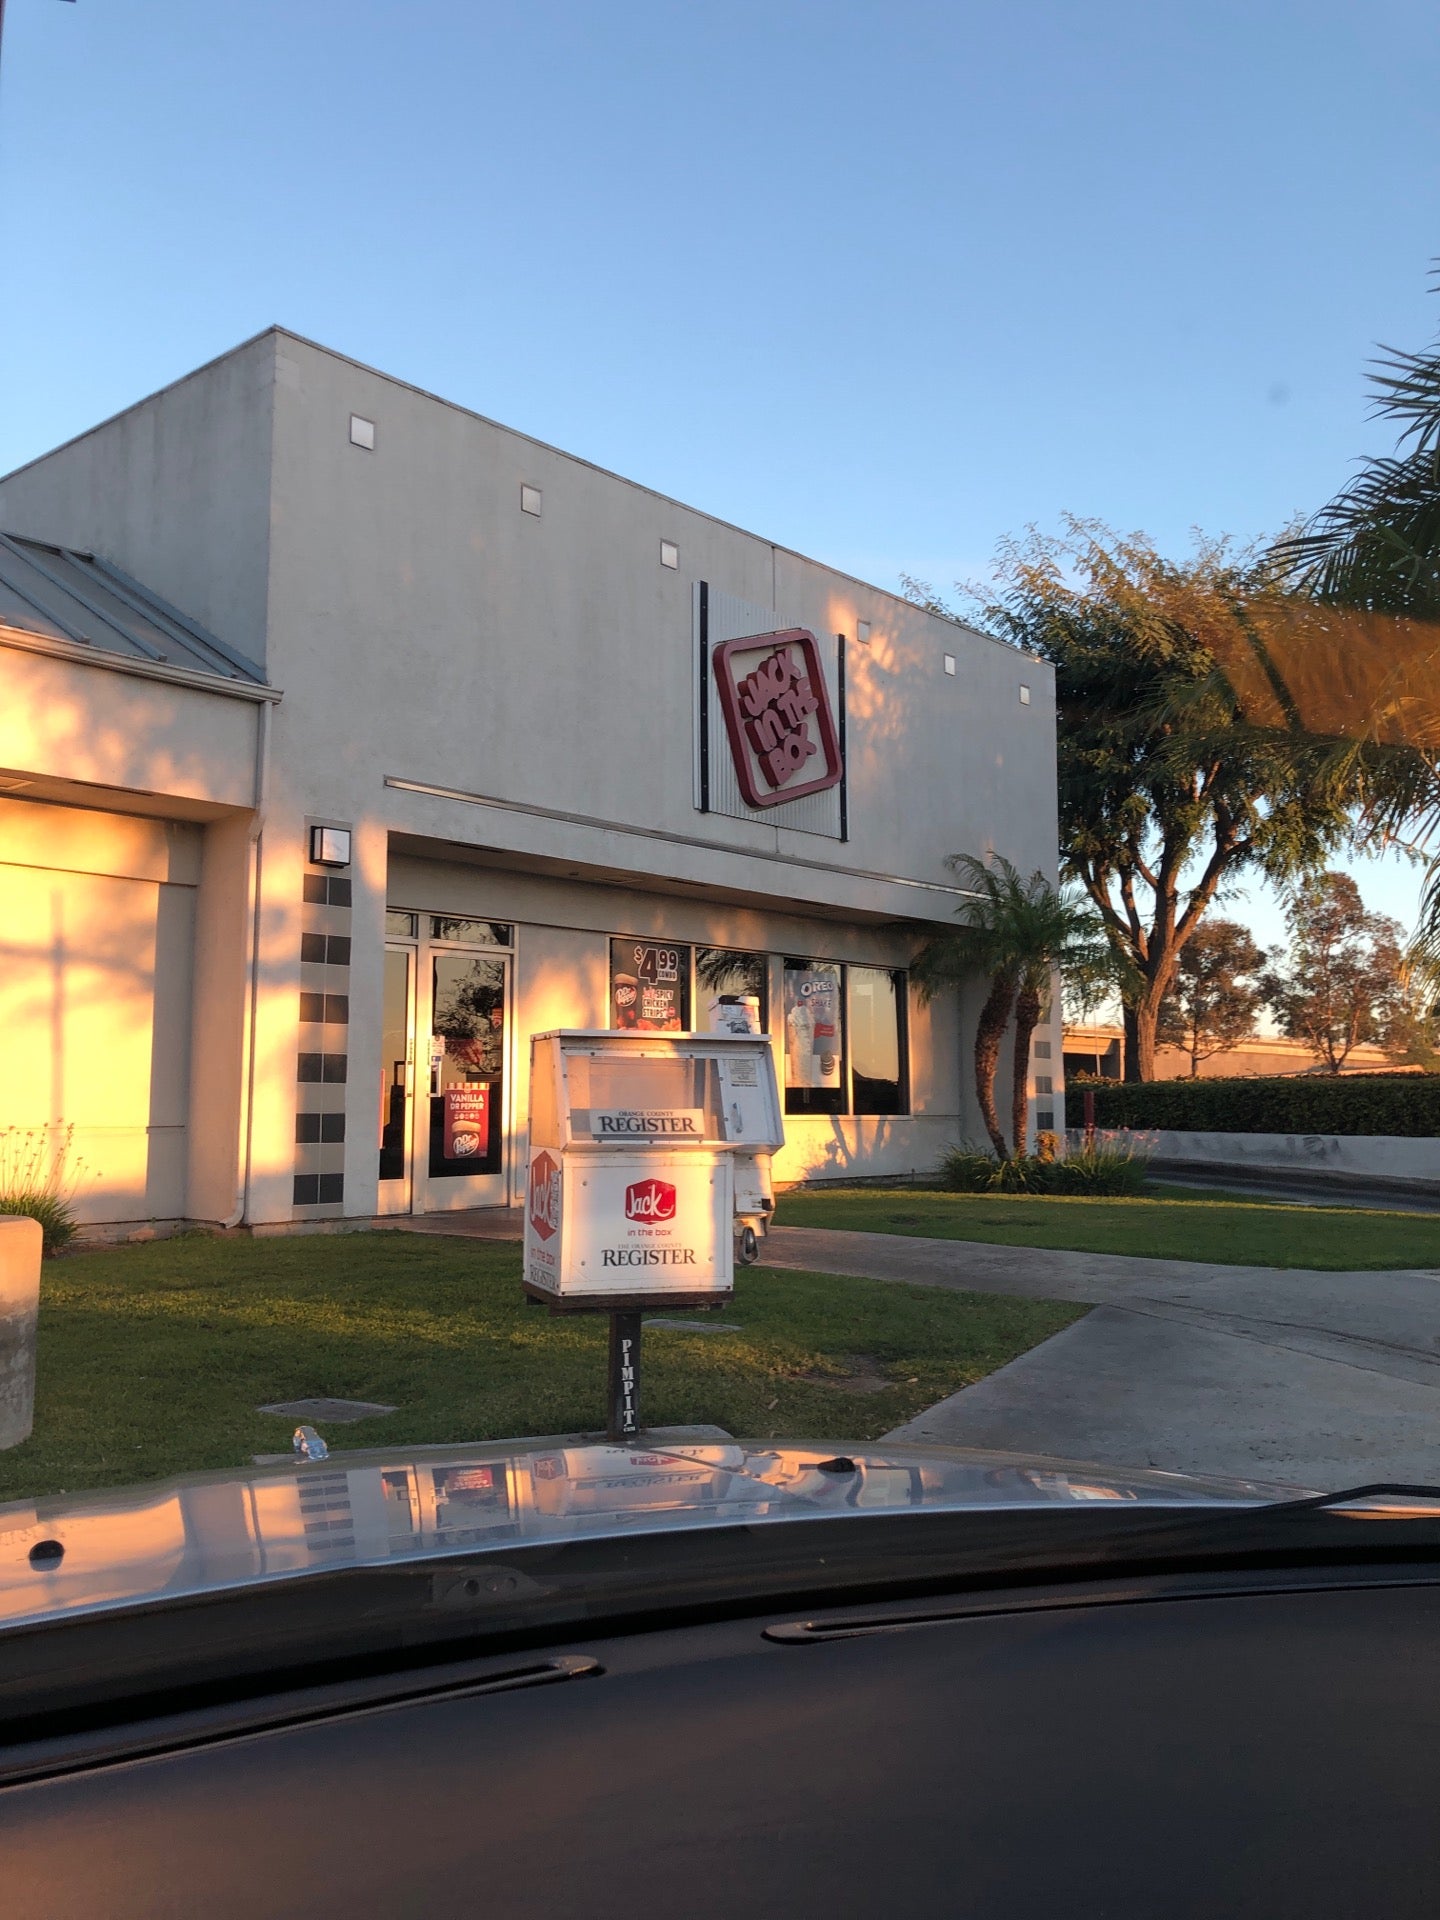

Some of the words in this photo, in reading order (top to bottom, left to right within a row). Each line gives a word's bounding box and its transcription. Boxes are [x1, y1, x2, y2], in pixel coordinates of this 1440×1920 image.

[740, 648, 801, 718] JACK
[748, 708, 786, 752] IN
[777, 677, 819, 728] THE
[763, 722, 817, 785] BOX
[656, 990, 674, 999] SPICY
[801, 981, 833, 997] OREO
[811, 998, 832, 1008] SHAKE
[450, 1094, 484, 1103] VANILLA
[460, 1102, 485, 1110] PEPPER
[598, 1115, 697, 1133] REGISTER
[626, 1184, 675, 1218] Jack
[638, 1229, 653, 1237] the
[655, 1229, 672, 1237] box
[601, 1249, 697, 1266] REGISTER
